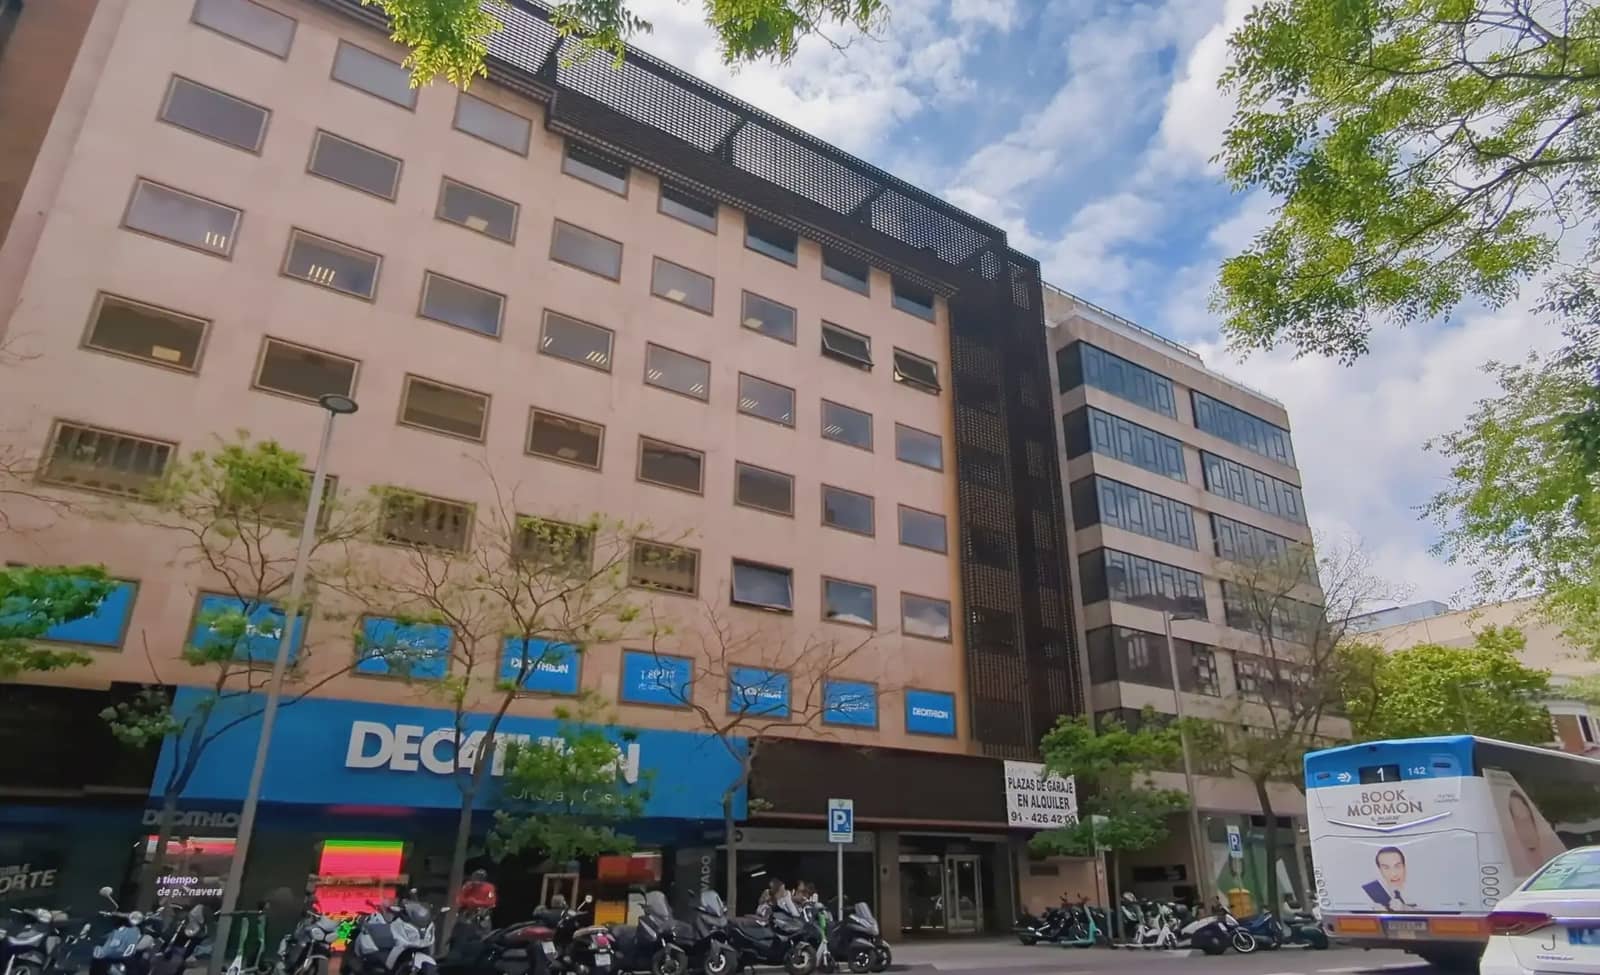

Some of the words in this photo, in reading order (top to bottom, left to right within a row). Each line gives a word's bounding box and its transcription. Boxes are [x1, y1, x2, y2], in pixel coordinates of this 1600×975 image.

[912, 707, 949, 719] DECATHLON
[345, 720, 641, 785] DECATN
[1376, 767, 1385, 782] 1
[1407, 767, 1426, 776] 142
[1007, 776, 1036, 791] PLAZAS
[1037, 780, 1047, 792] DE
[1047, 780, 1073, 793] GARAJE
[1017, 793, 1029, 808] EN
[1031, 795, 1071, 810] ALQUILER
[1361, 789, 1407, 804] BOOK
[1347, 801, 1424, 817] MORMON
[1010, 811, 1023, 822] 91
[1031, 813, 1049, 824] 426
[1051, 814, 1063, 824] 42
[162, 875, 199, 886] tiempo
[156, 886, 170, 897] de
